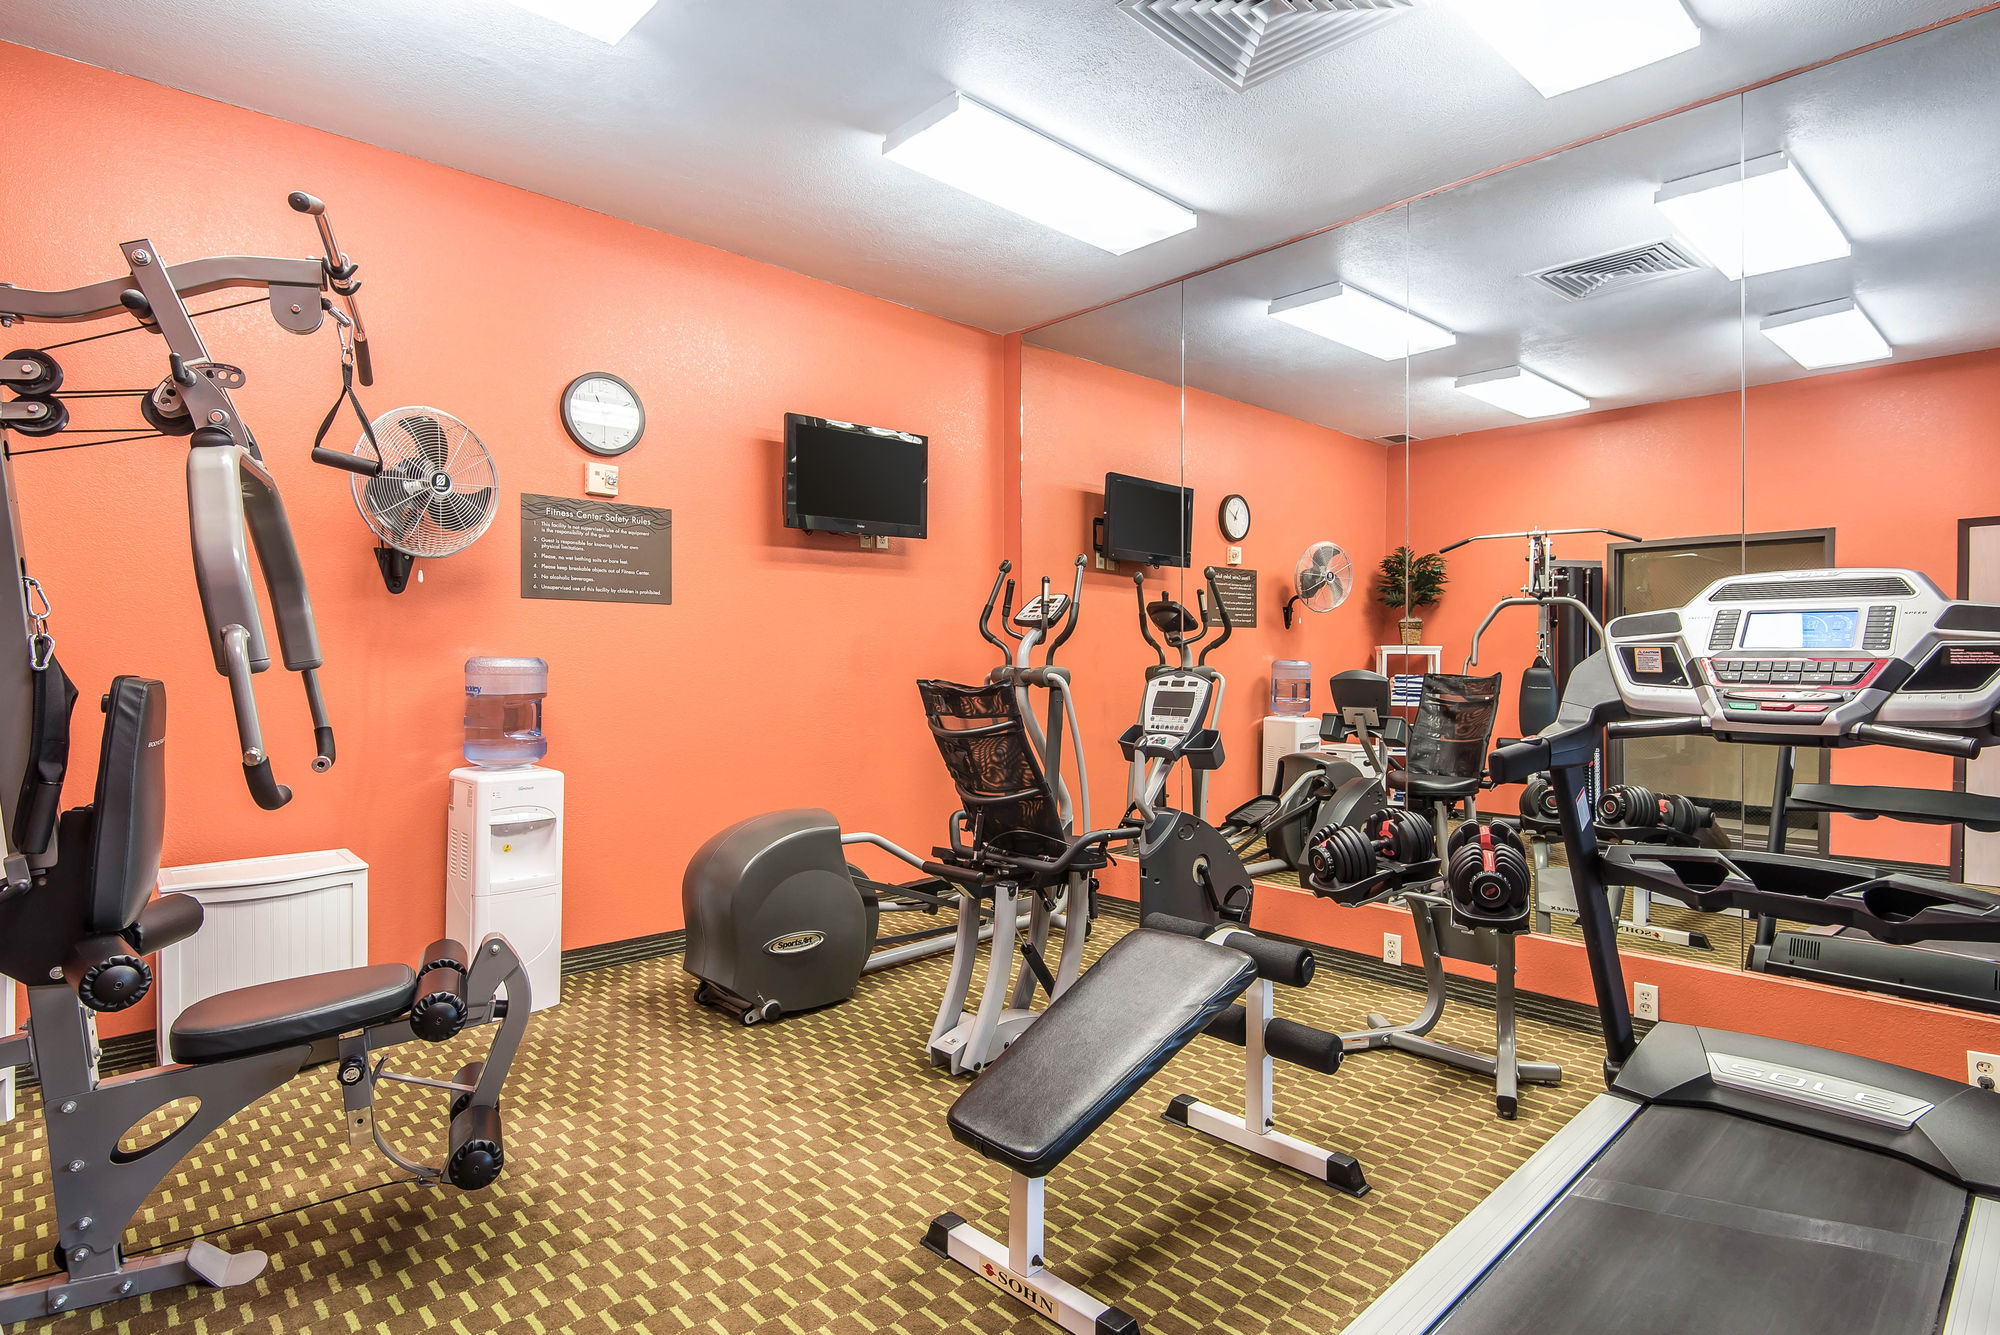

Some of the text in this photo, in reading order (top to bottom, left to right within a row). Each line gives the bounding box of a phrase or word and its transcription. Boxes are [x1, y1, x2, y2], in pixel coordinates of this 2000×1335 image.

[546, 507, 650, 526] Fitness Center Safety Rules
[554, 529, 584, 537] responsibility
[595, 586, 610, 594] facility
[1730, 1063, 1895, 1110] SOLE
[998, 1271, 1054, 1314] SOHN
